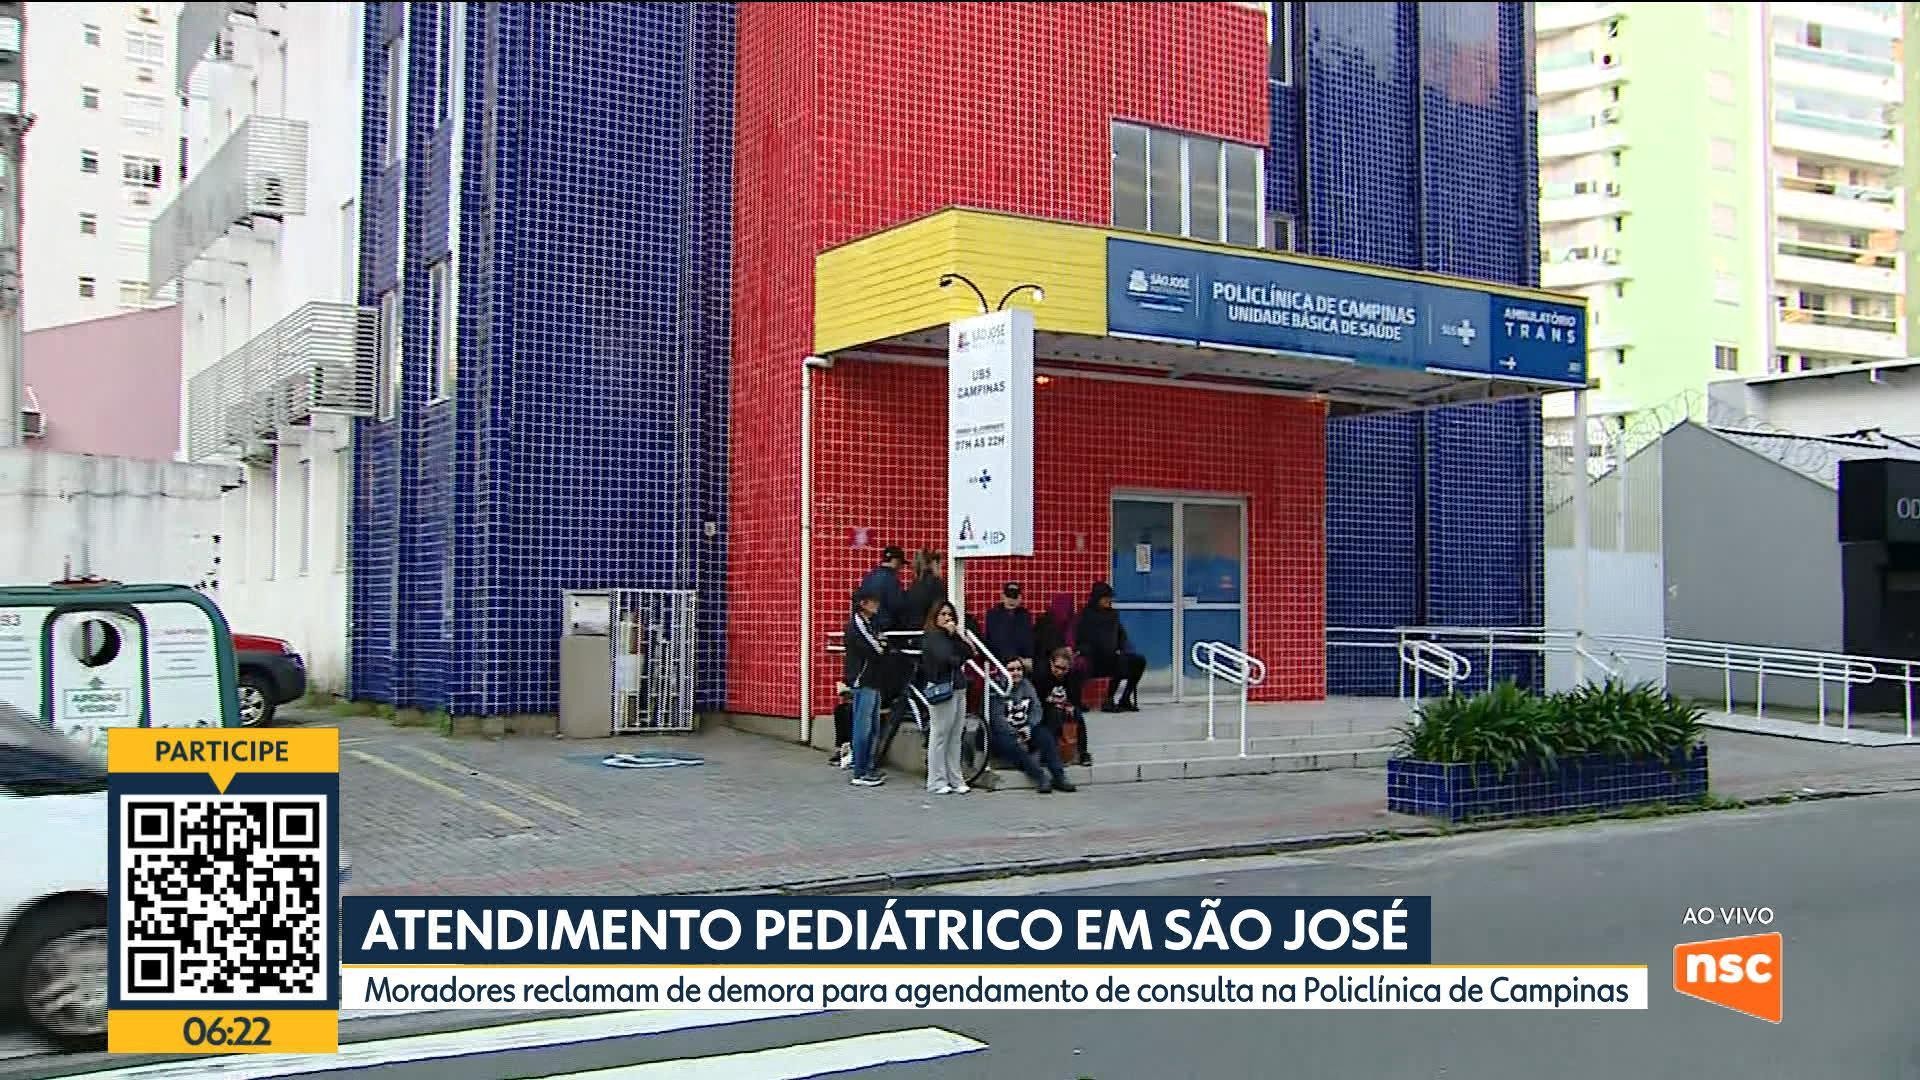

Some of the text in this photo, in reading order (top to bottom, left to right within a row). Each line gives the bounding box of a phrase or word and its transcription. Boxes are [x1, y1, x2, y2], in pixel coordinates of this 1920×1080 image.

[1212, 280, 1416, 326] POLICLÍNICA DE CAMPINAS
[1227, 304, 1402, 342] UNIDADE BÁSICA DE SAÚDE
[1504, 306, 1577, 328] AMBULATÓRIO
[1504, 321, 1577, 345] TRANS
[972, 366, 991, 382] UBS
[957, 380, 1006, 400] CAMPINAS
